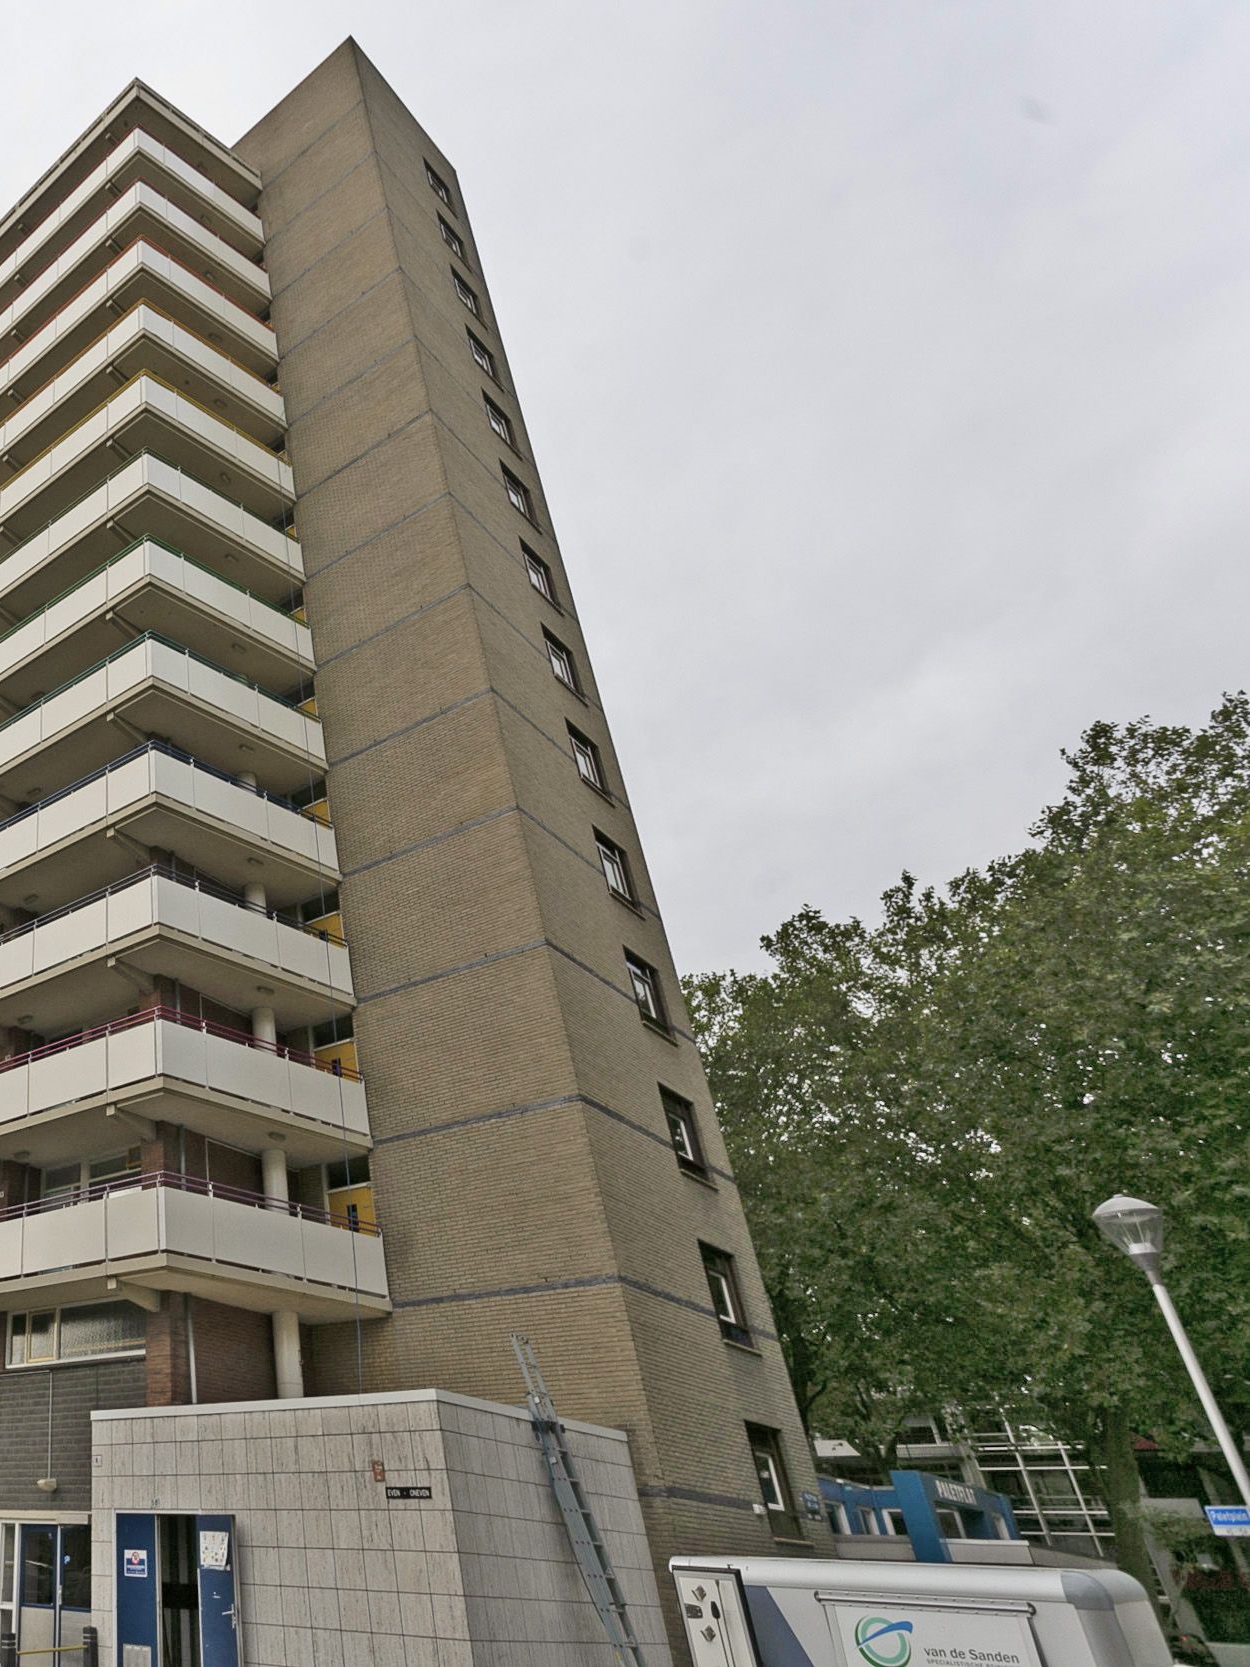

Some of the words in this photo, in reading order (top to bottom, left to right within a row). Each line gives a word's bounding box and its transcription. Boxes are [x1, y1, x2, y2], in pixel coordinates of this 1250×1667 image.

[387, 1489, 401, 1497] EVEN
[410, 1489, 430, 1497] ONEVEN
[935, 1479, 978, 1505] PALETFLAT
[1210, 1510, 1249, 1522] Paletplein
[924, 1647, 947, 1658] van
[950, 1648, 966, 1660] de
[968, 1649, 1020, 1664] Sanden
